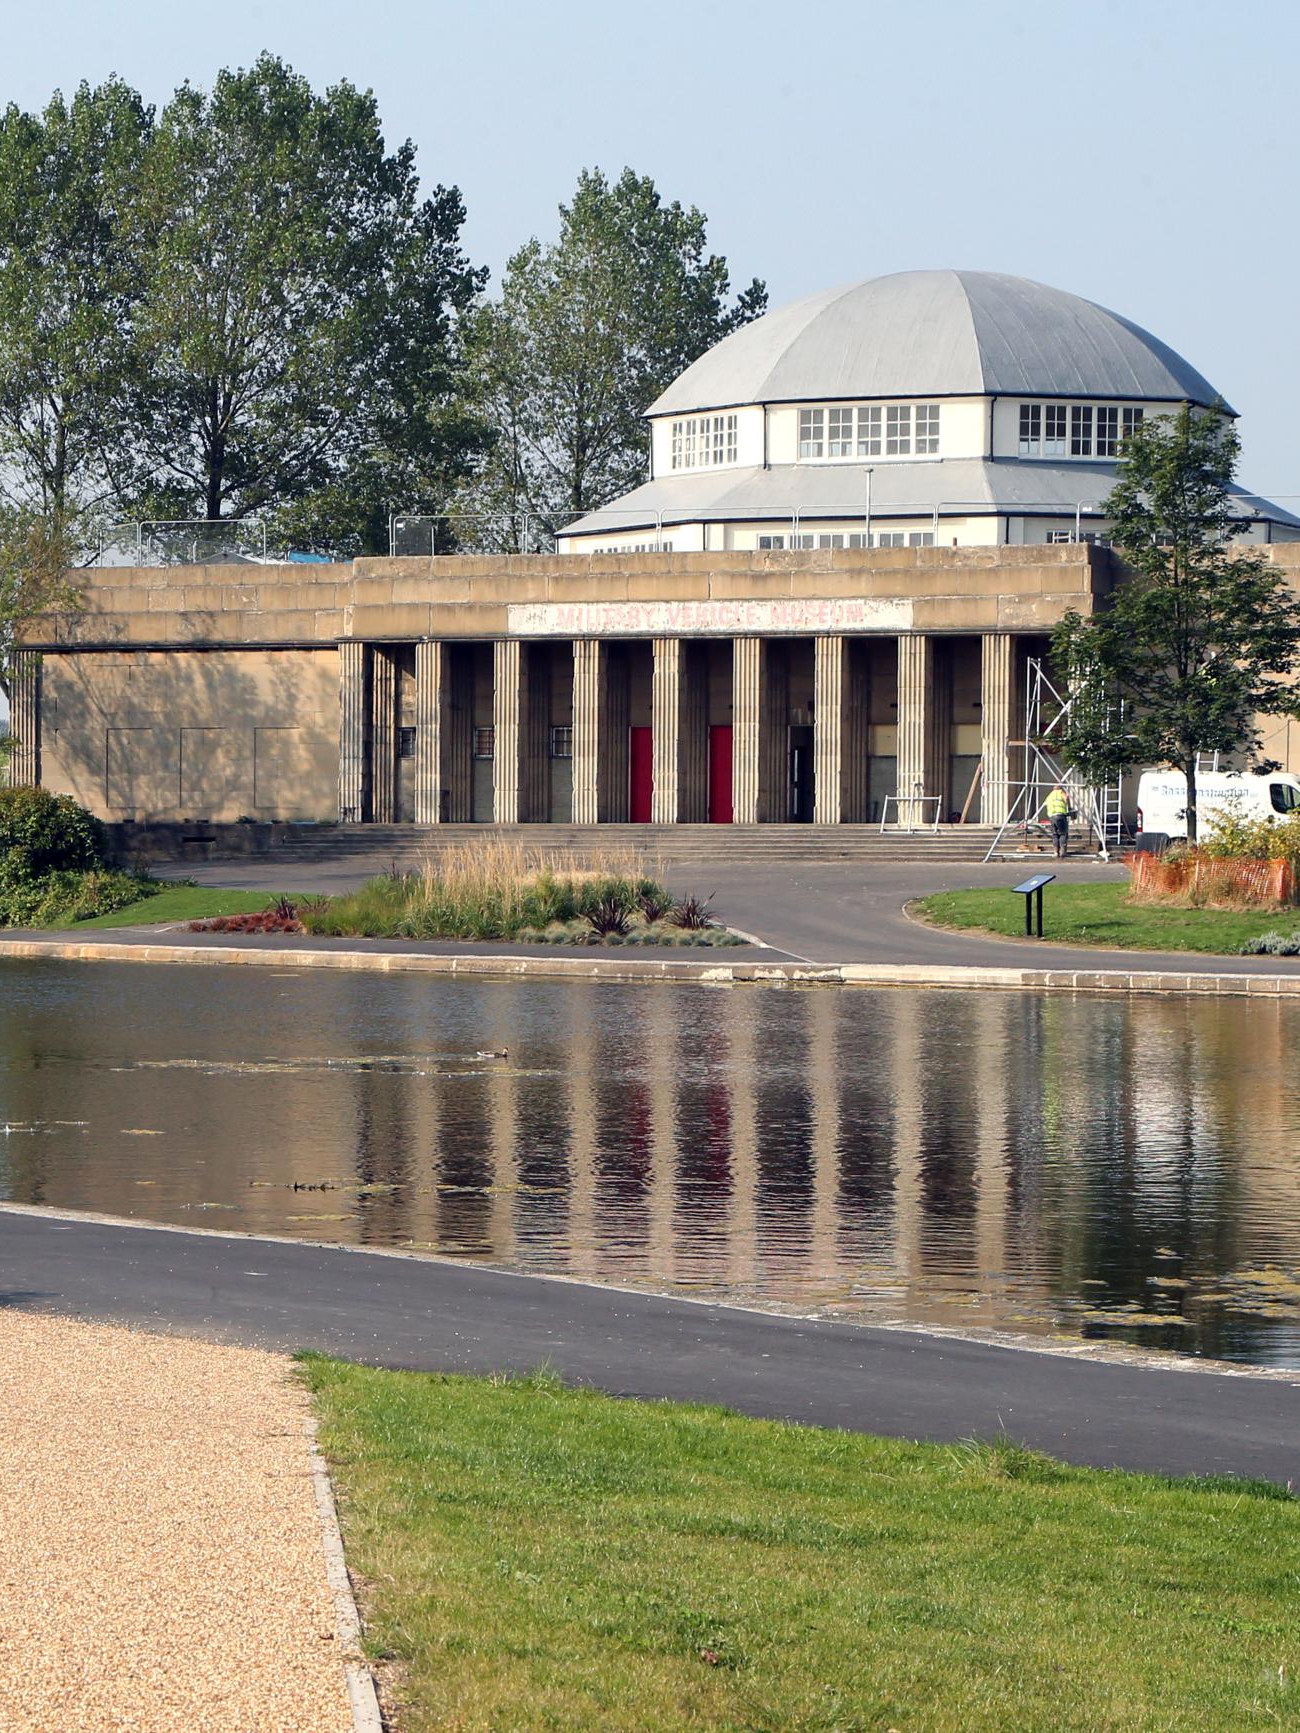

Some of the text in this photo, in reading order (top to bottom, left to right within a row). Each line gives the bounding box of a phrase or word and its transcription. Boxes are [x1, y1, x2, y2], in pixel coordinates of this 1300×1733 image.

[556, 603, 864, 627] MILITARY VEHICLE MUSEUM
